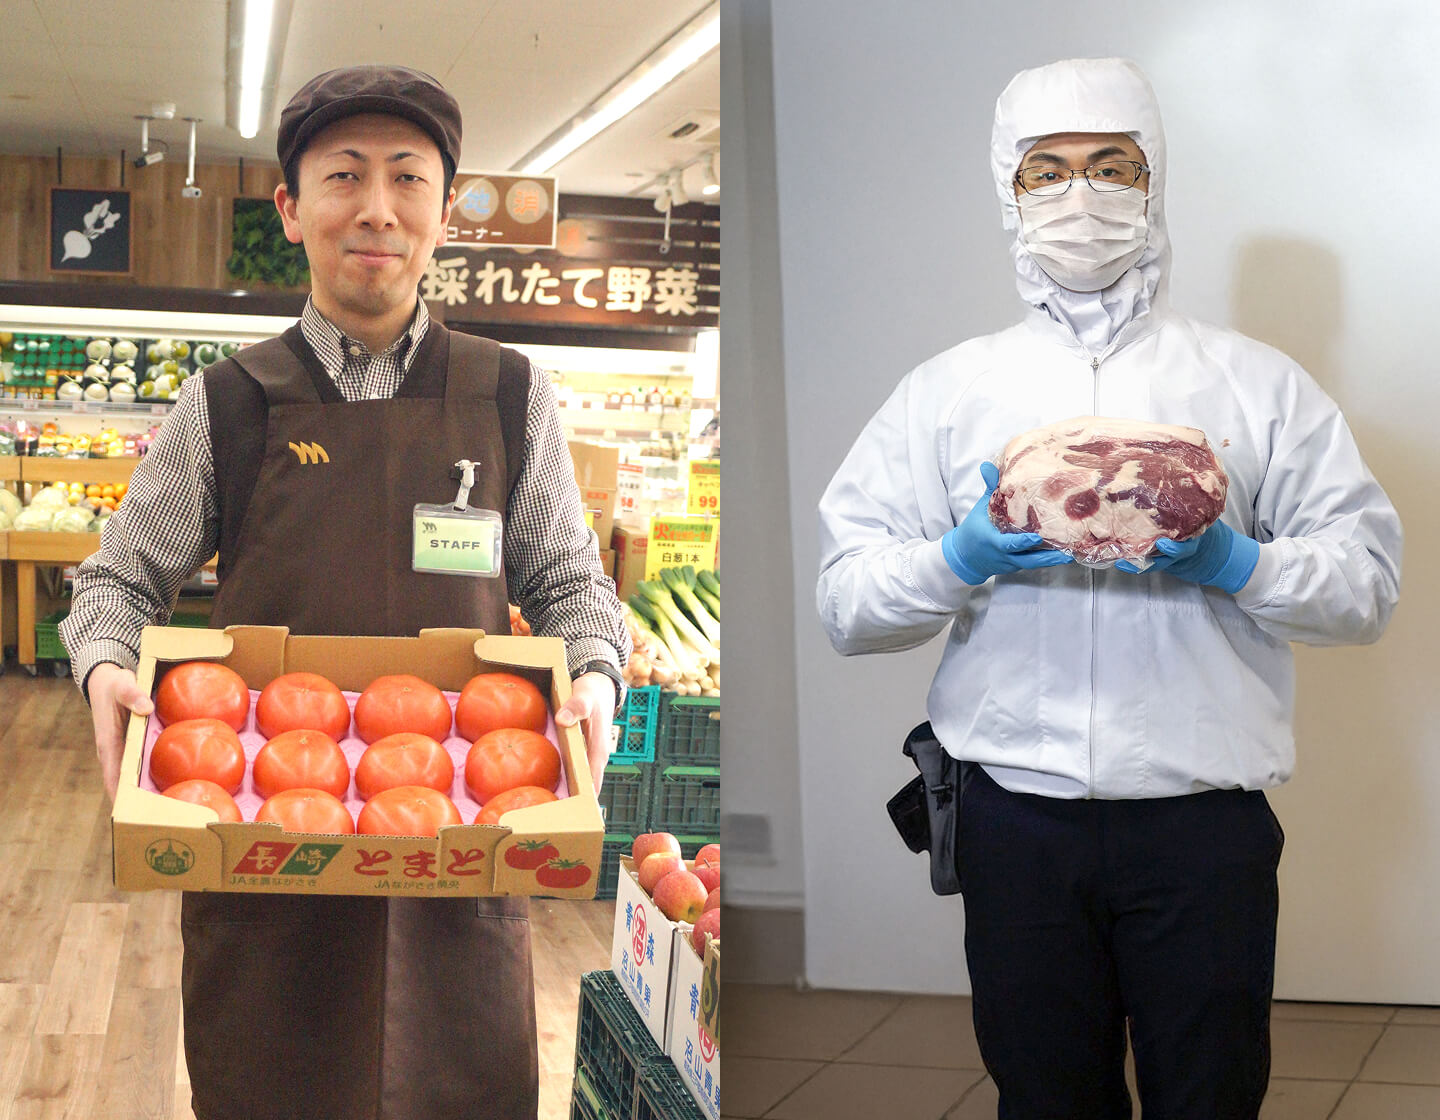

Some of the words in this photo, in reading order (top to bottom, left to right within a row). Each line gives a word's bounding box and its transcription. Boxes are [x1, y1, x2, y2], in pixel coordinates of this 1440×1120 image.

[421, 256, 700, 316] 採れたて野菜
[698, 496, 718, 508] 99
[430, 539, 480, 550] STAFF
[246, 845, 328, 873] 長崎
[354, 848, 485, 878] とまと
